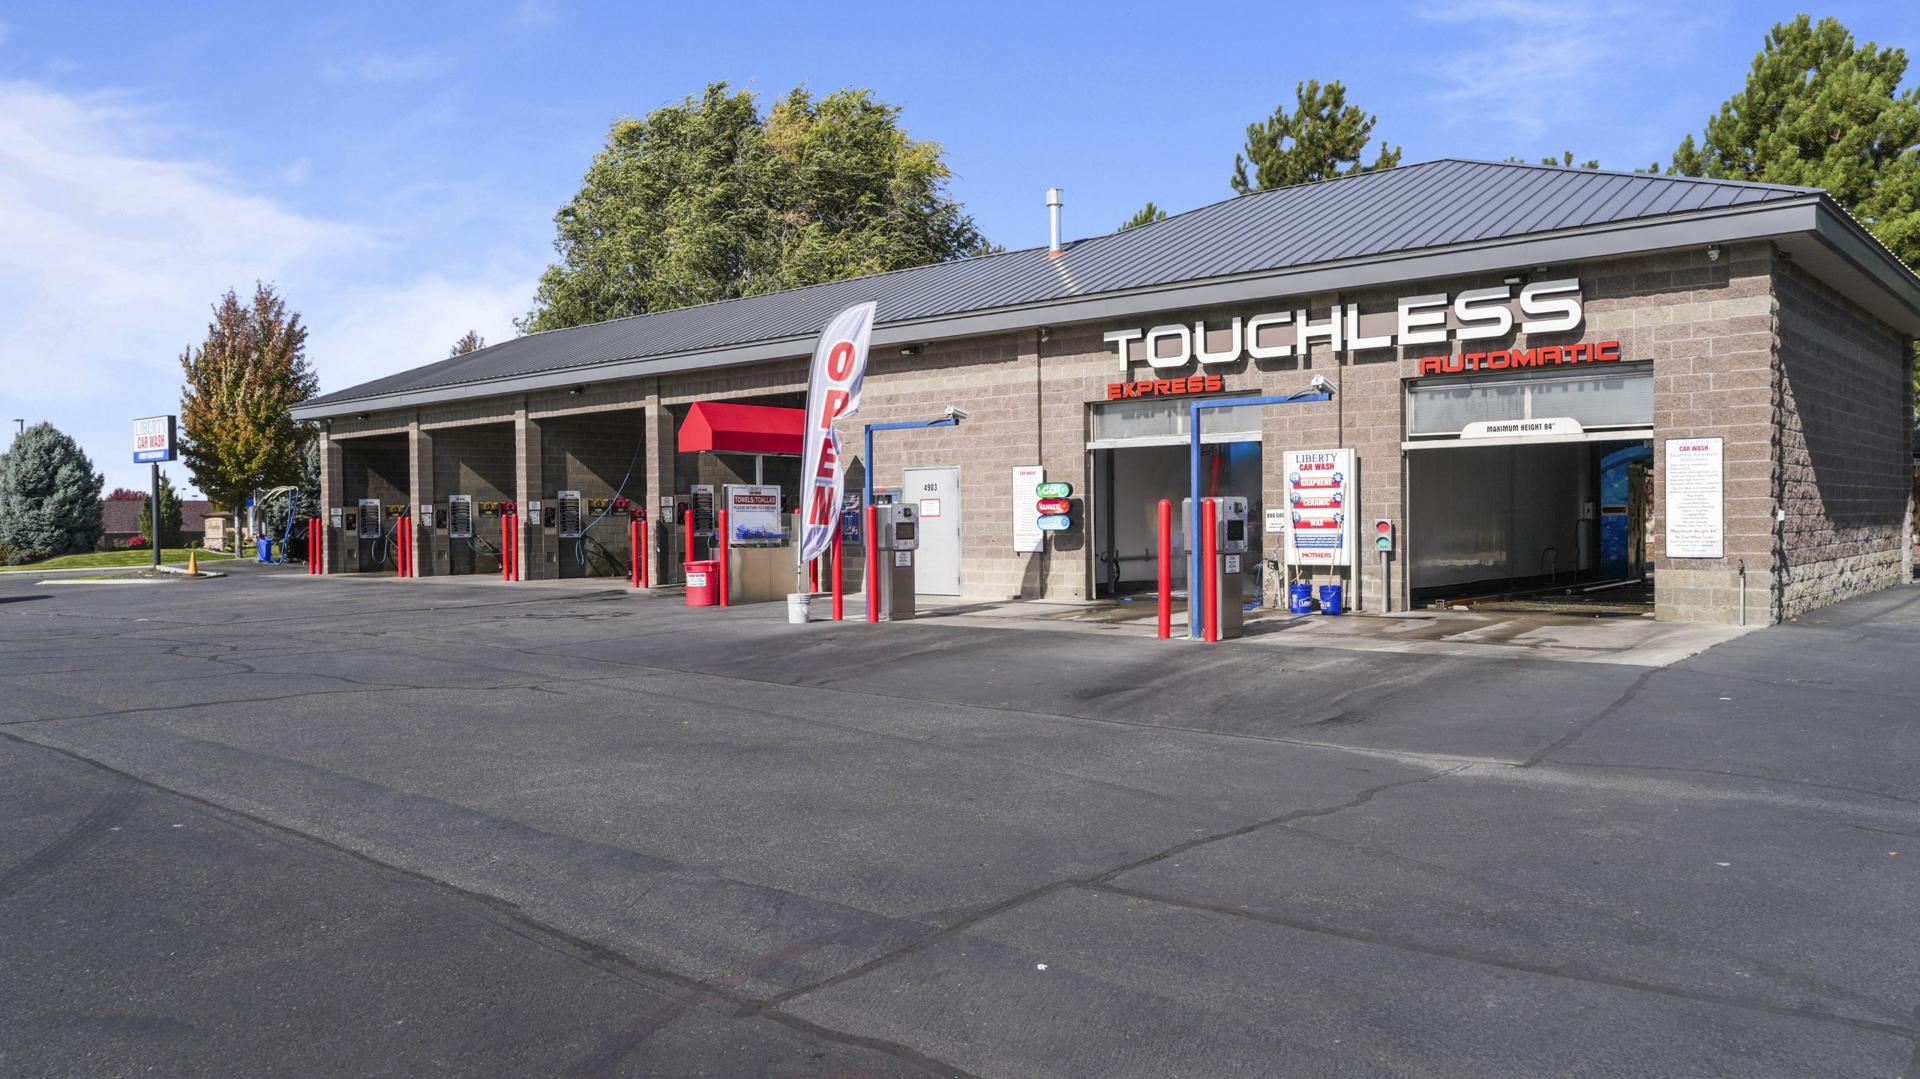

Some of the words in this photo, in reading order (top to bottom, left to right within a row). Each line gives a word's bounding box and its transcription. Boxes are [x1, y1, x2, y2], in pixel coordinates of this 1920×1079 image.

[1104, 278, 1582, 371] TOUCHLESS
[1419, 341, 1620, 376] AUTOMATIC
[1107, 375, 1222, 399] EXPRESS
[809, 342, 855, 525] OPEN
[1486, 424, 1519, 433] MAXIMUM
[1520, 423, 1542, 431] HEIGHT
[137, 436, 148, 449] CAR
[149, 434, 165, 448] WASH
[1296, 453, 1337, 464] LIBERTY
[1314, 463, 1335, 471] WASH
